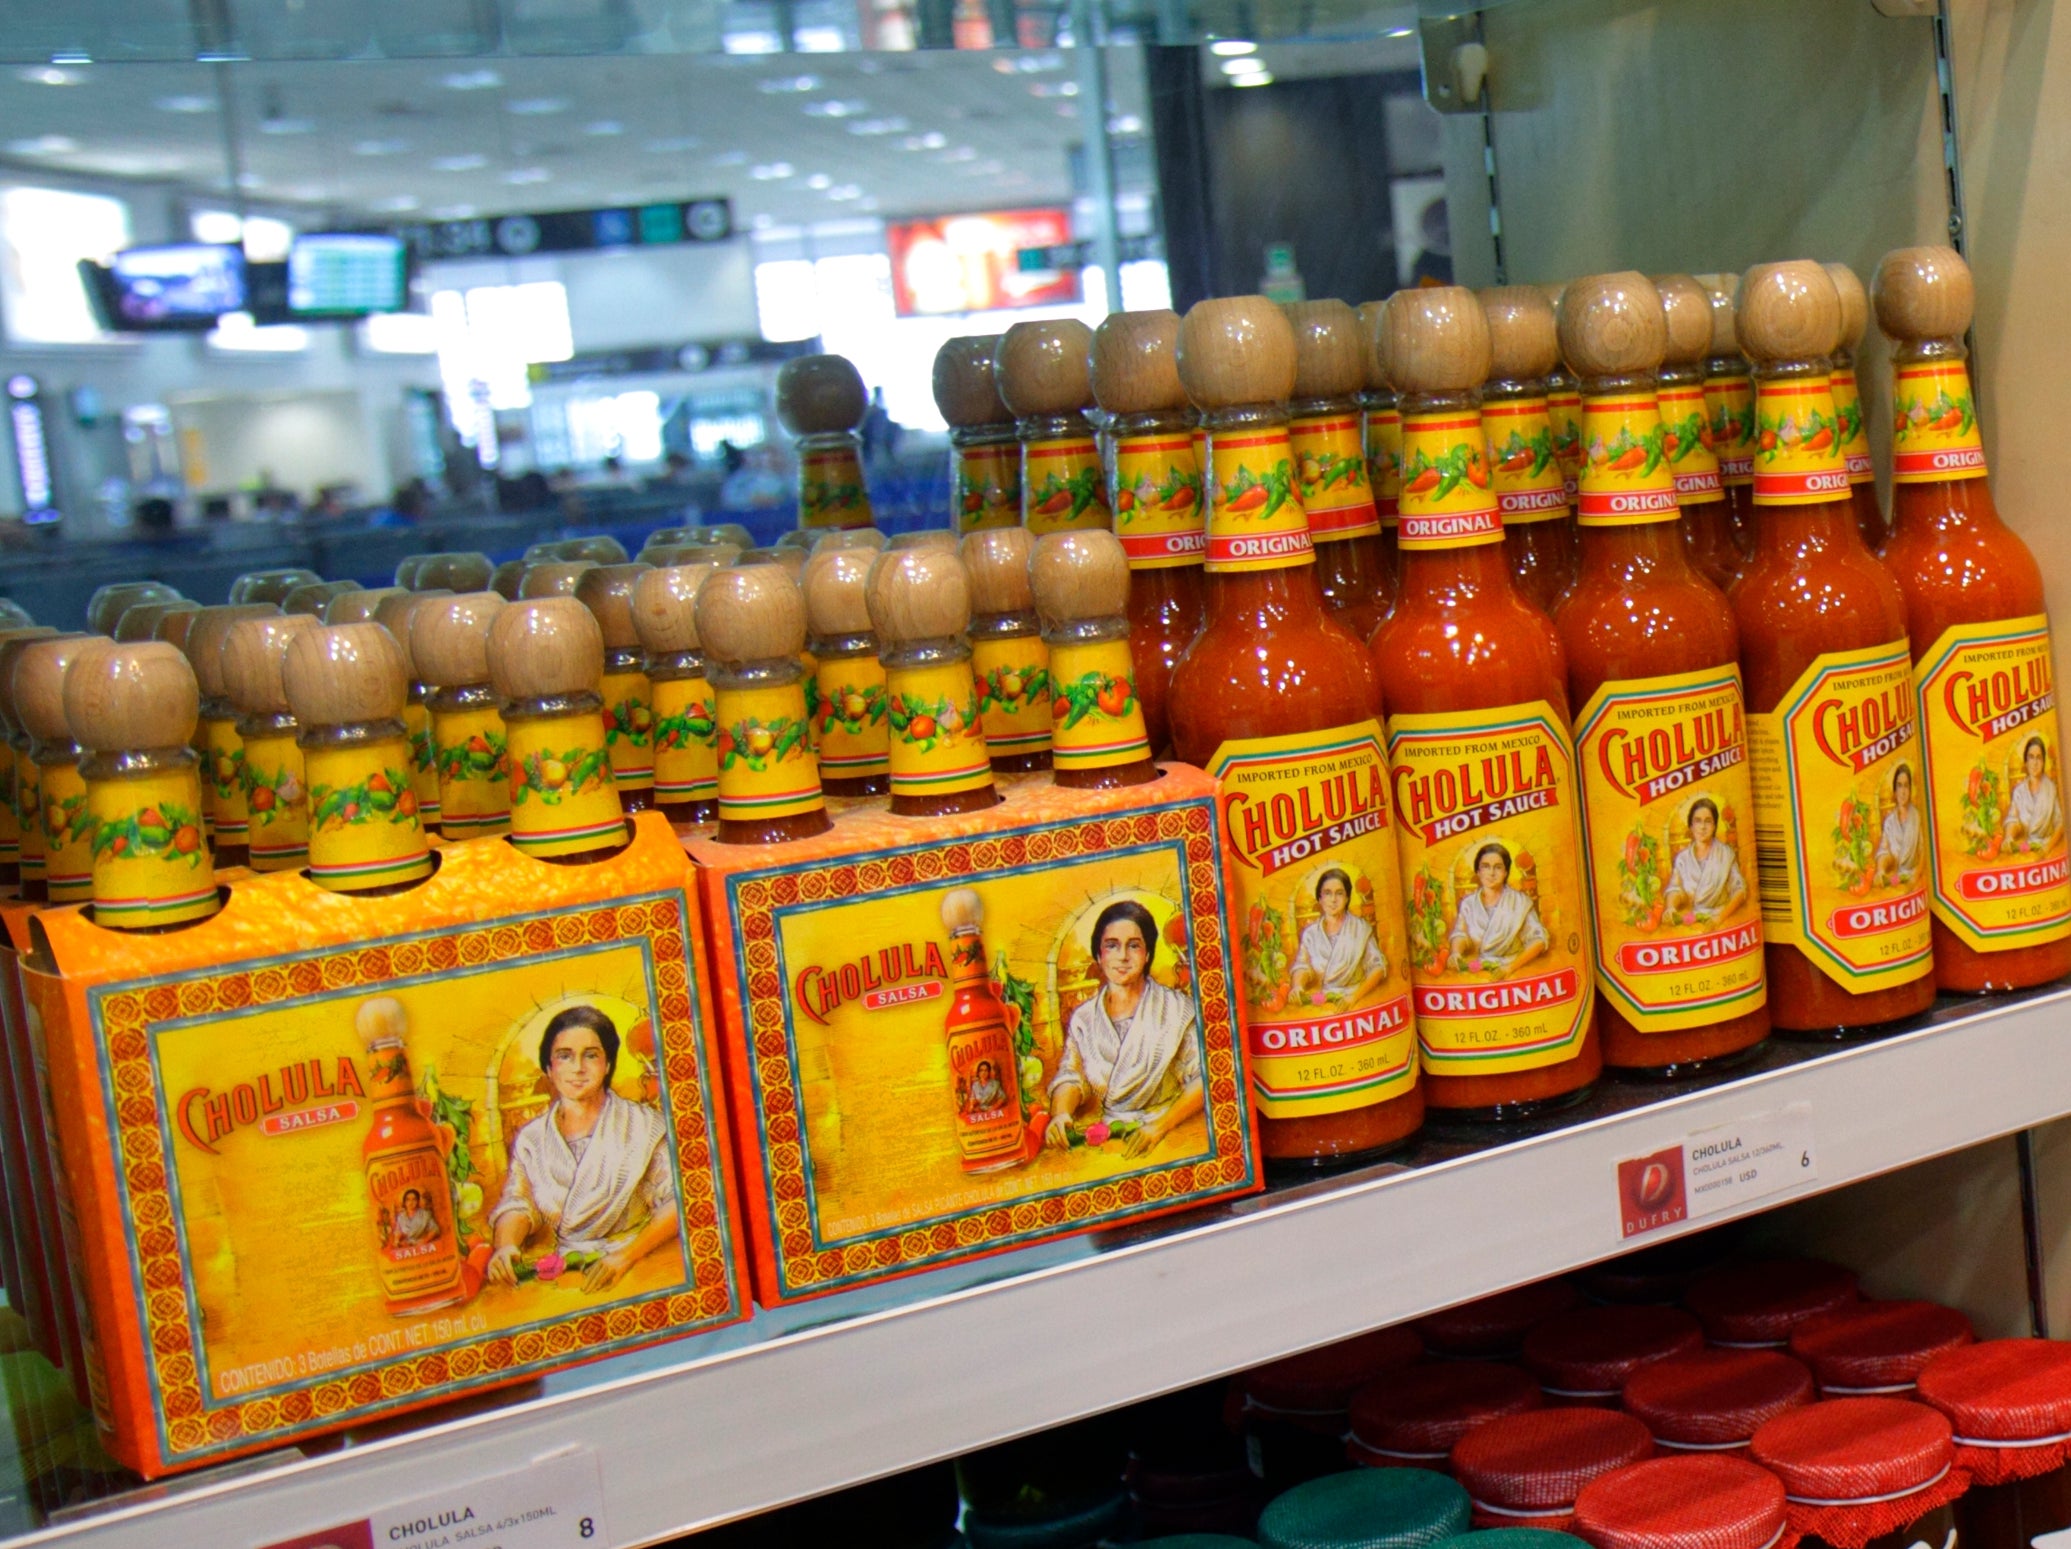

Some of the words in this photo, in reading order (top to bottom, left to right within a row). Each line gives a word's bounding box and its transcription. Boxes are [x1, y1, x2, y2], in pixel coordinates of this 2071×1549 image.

[1406, 514, 1495, 536] ORIGINAL
[1963, 649, 2014, 664] IMPORTED
[1832, 674, 1884, 691] IMPORTED
[1617, 705, 1675, 721] IMPORTED
[1678, 701, 1706, 716] FROM
[1991, 705, 2030, 736] HOT
[1404, 746, 1461, 758] IMPORTED
[1465, 742, 1498, 755] FROM
[1501, 735, 1541, 750] MEXICO
[1598, 702, 1745, 800] CHOLULA
[1861, 731, 1898, 765] HOT
[1237, 767, 1300, 783] IMPORTED
[1304, 762, 1337, 777] FROM
[1339, 754, 1373, 771] MEXICO
[1390, 744, 1558, 840] CHOLULA
[1648, 765, 1695, 798] HOT
[1224, 764, 1388, 870] CHOLULA
[1434, 808, 1483, 840] HOT
[1489, 791, 1549, 821] SAUCE
[1272, 832, 1323, 869] HOT
[1329, 811, 1382, 846] SAUCE
[2006, 908, 2017, 920] 12
[1636, 927, 1759, 967] ORIGINAL
[1880, 945, 1889, 957] 12
[796, 941, 949, 1026] CHOLULA
[877, 984, 929, 1006] SALSA
[1423, 977, 1568, 1011] ORIGINAL
[1669, 984, 1681, 996] 12
[1262, 1005, 1404, 1050] ORIGINAL
[1454, 1032, 1466, 1044] 12
[1512, 1025, 1531, 1039] 360
[1534, 1022, 1548, 1035] mL
[1297, 1069, 1310, 1082] 12
[1357, 1056, 1375, 1072] 360
[1377, 1052, 1391, 1066] mL
[177, 1056, 367, 1155] CHOLULA
[279, 1106, 341, 1130] SALSA
[969, 1109, 1004, 1124] SALSA
[1692, 1136, 1743, 1161] CHOLULA
[1801, 1149, 1810, 1168] 6
[1693, 1159, 1728, 1176] CHOLULA
[1728, 1151, 1751, 1165] SALSA
[1739, 1168, 1757, 1183] USD
[1626, 1206, 1683, 1234] DUFRY
[395, 1242, 437, 1260] SALSA
[299, 1356, 308, 1374] 3
[352, 1340, 367, 1360] de
[432, 1318, 452, 1339] 150
[389, 1507, 475, 1541] CHOLULA
[455, 1523, 494, 1542] SALSA
[579, 1517, 594, 1539] 8
